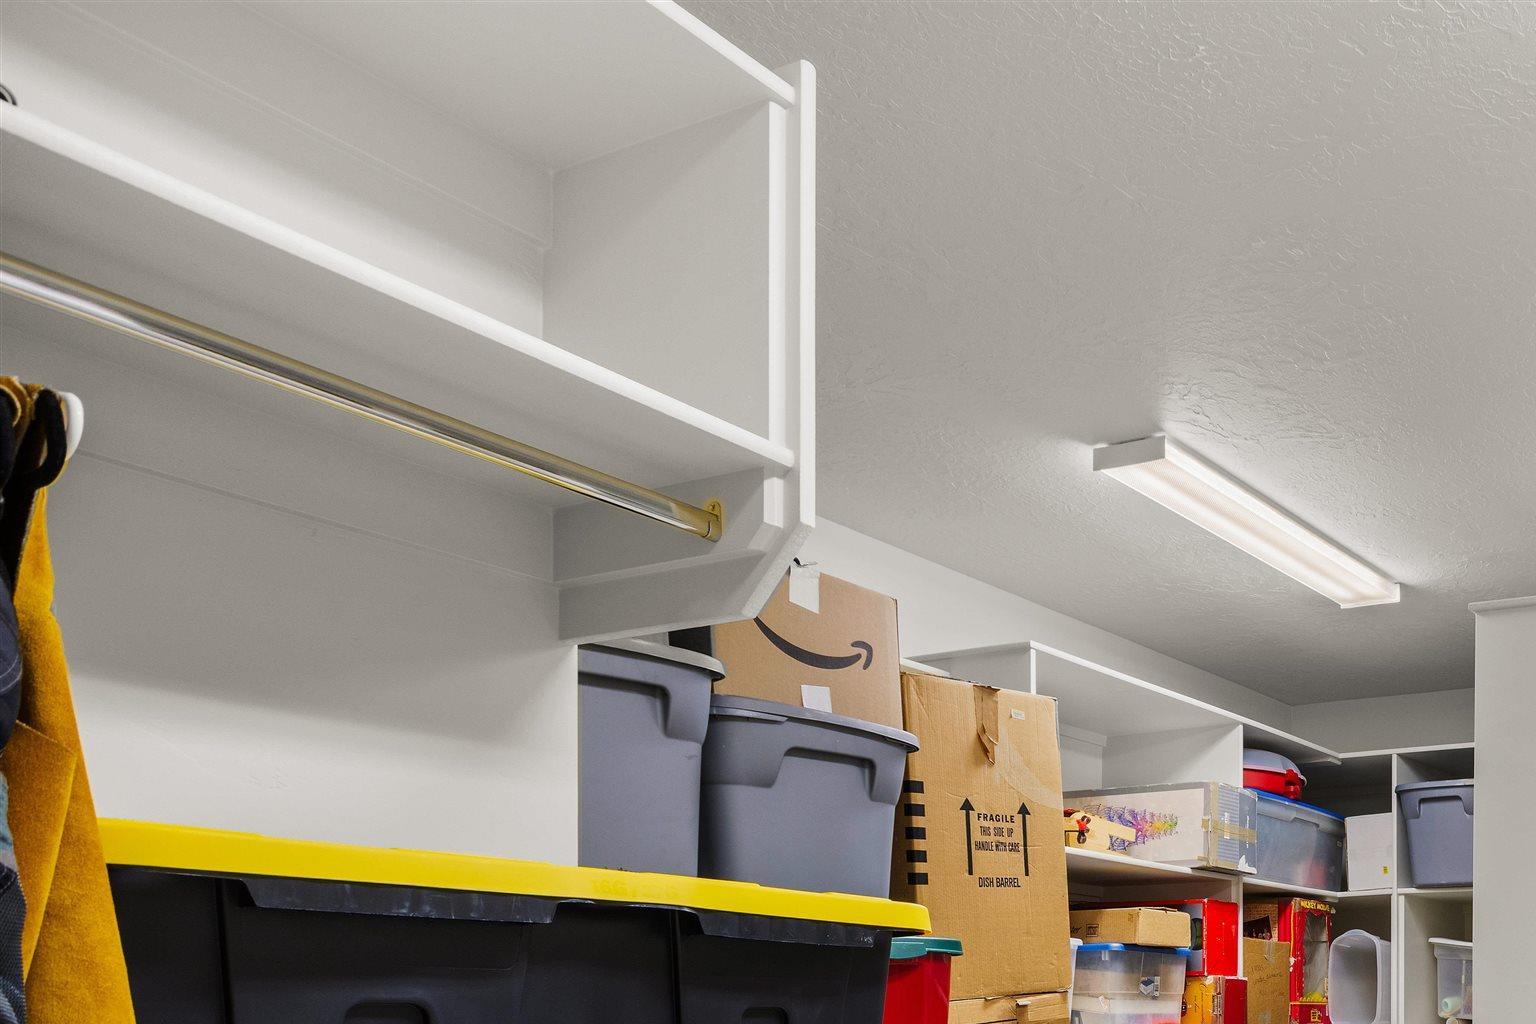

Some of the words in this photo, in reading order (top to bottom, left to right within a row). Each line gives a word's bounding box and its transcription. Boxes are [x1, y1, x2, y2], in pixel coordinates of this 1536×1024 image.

[977, 813, 1015, 824] FRAGILE
[979, 826, 992, 837] THIS
[993, 827, 1005, 838] SIDE
[1006, 828, 1014, 838] UP
[974, 841, 994, 852] HANDLE
[1007, 842, 1021, 853] CARE
[978, 877, 995, 888] DISH
[996, 878, 1021, 888] BARREL
